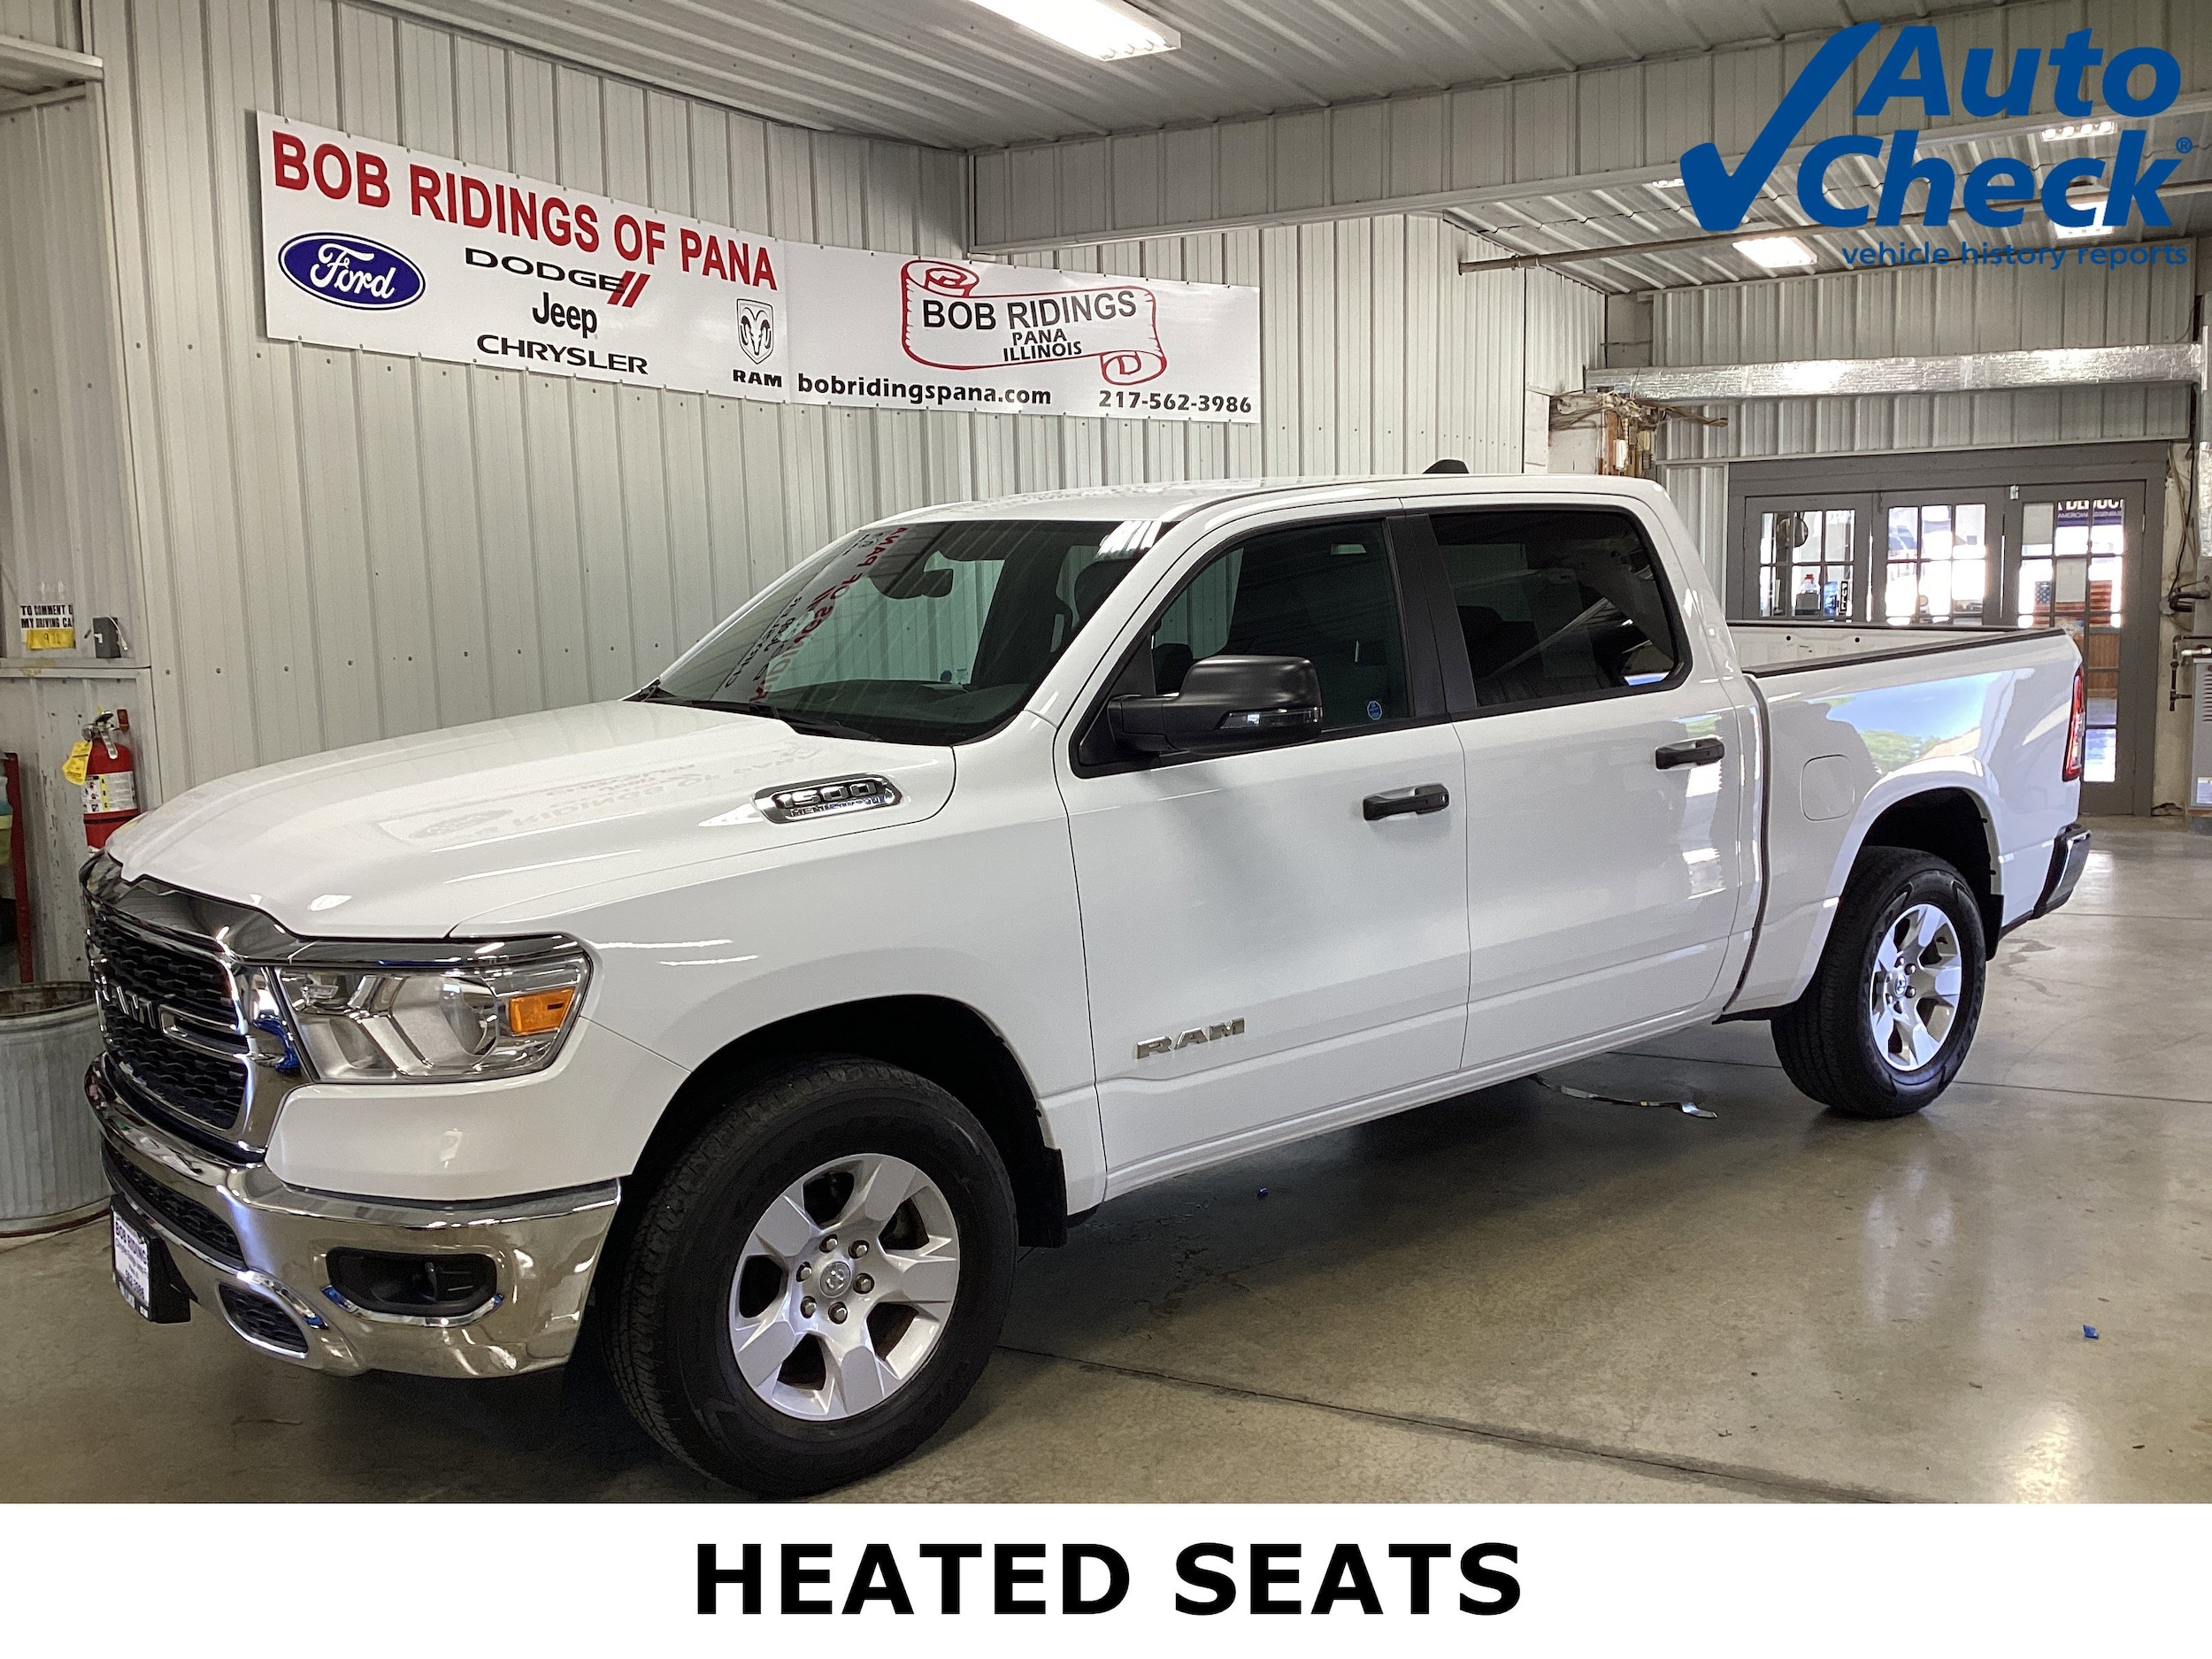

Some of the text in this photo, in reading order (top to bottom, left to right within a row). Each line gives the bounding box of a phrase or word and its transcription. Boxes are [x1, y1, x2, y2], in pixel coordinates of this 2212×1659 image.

[273, 130, 778, 291] BOB RIDINGS OF PANA
[311, 243, 396, 299] Ford
[465, 247, 625, 294] DODGE
[532, 291, 597, 339] Jeep
[923, 290, 1137, 330] BOB RIDINGS
[1003, 341, 1082, 361] ILLINOIS
[1012, 327, 1067, 346] PANA
[477, 334, 649, 375] CHRYSLER
[733, 369, 782, 388] RAM
[798, 373, 1051, 404] bobridingspana.com
[1099, 390, 1252, 413] 217-562-3986
[20, 604, 33, 616] TO
[34, 604, 65, 616] COMMENT
[20, 618, 34, 628] MY
[35, 617, 60, 628] DRIVING
[777, 782, 877, 808] 1500
[1134, 1018, 1245, 1059] RAM
